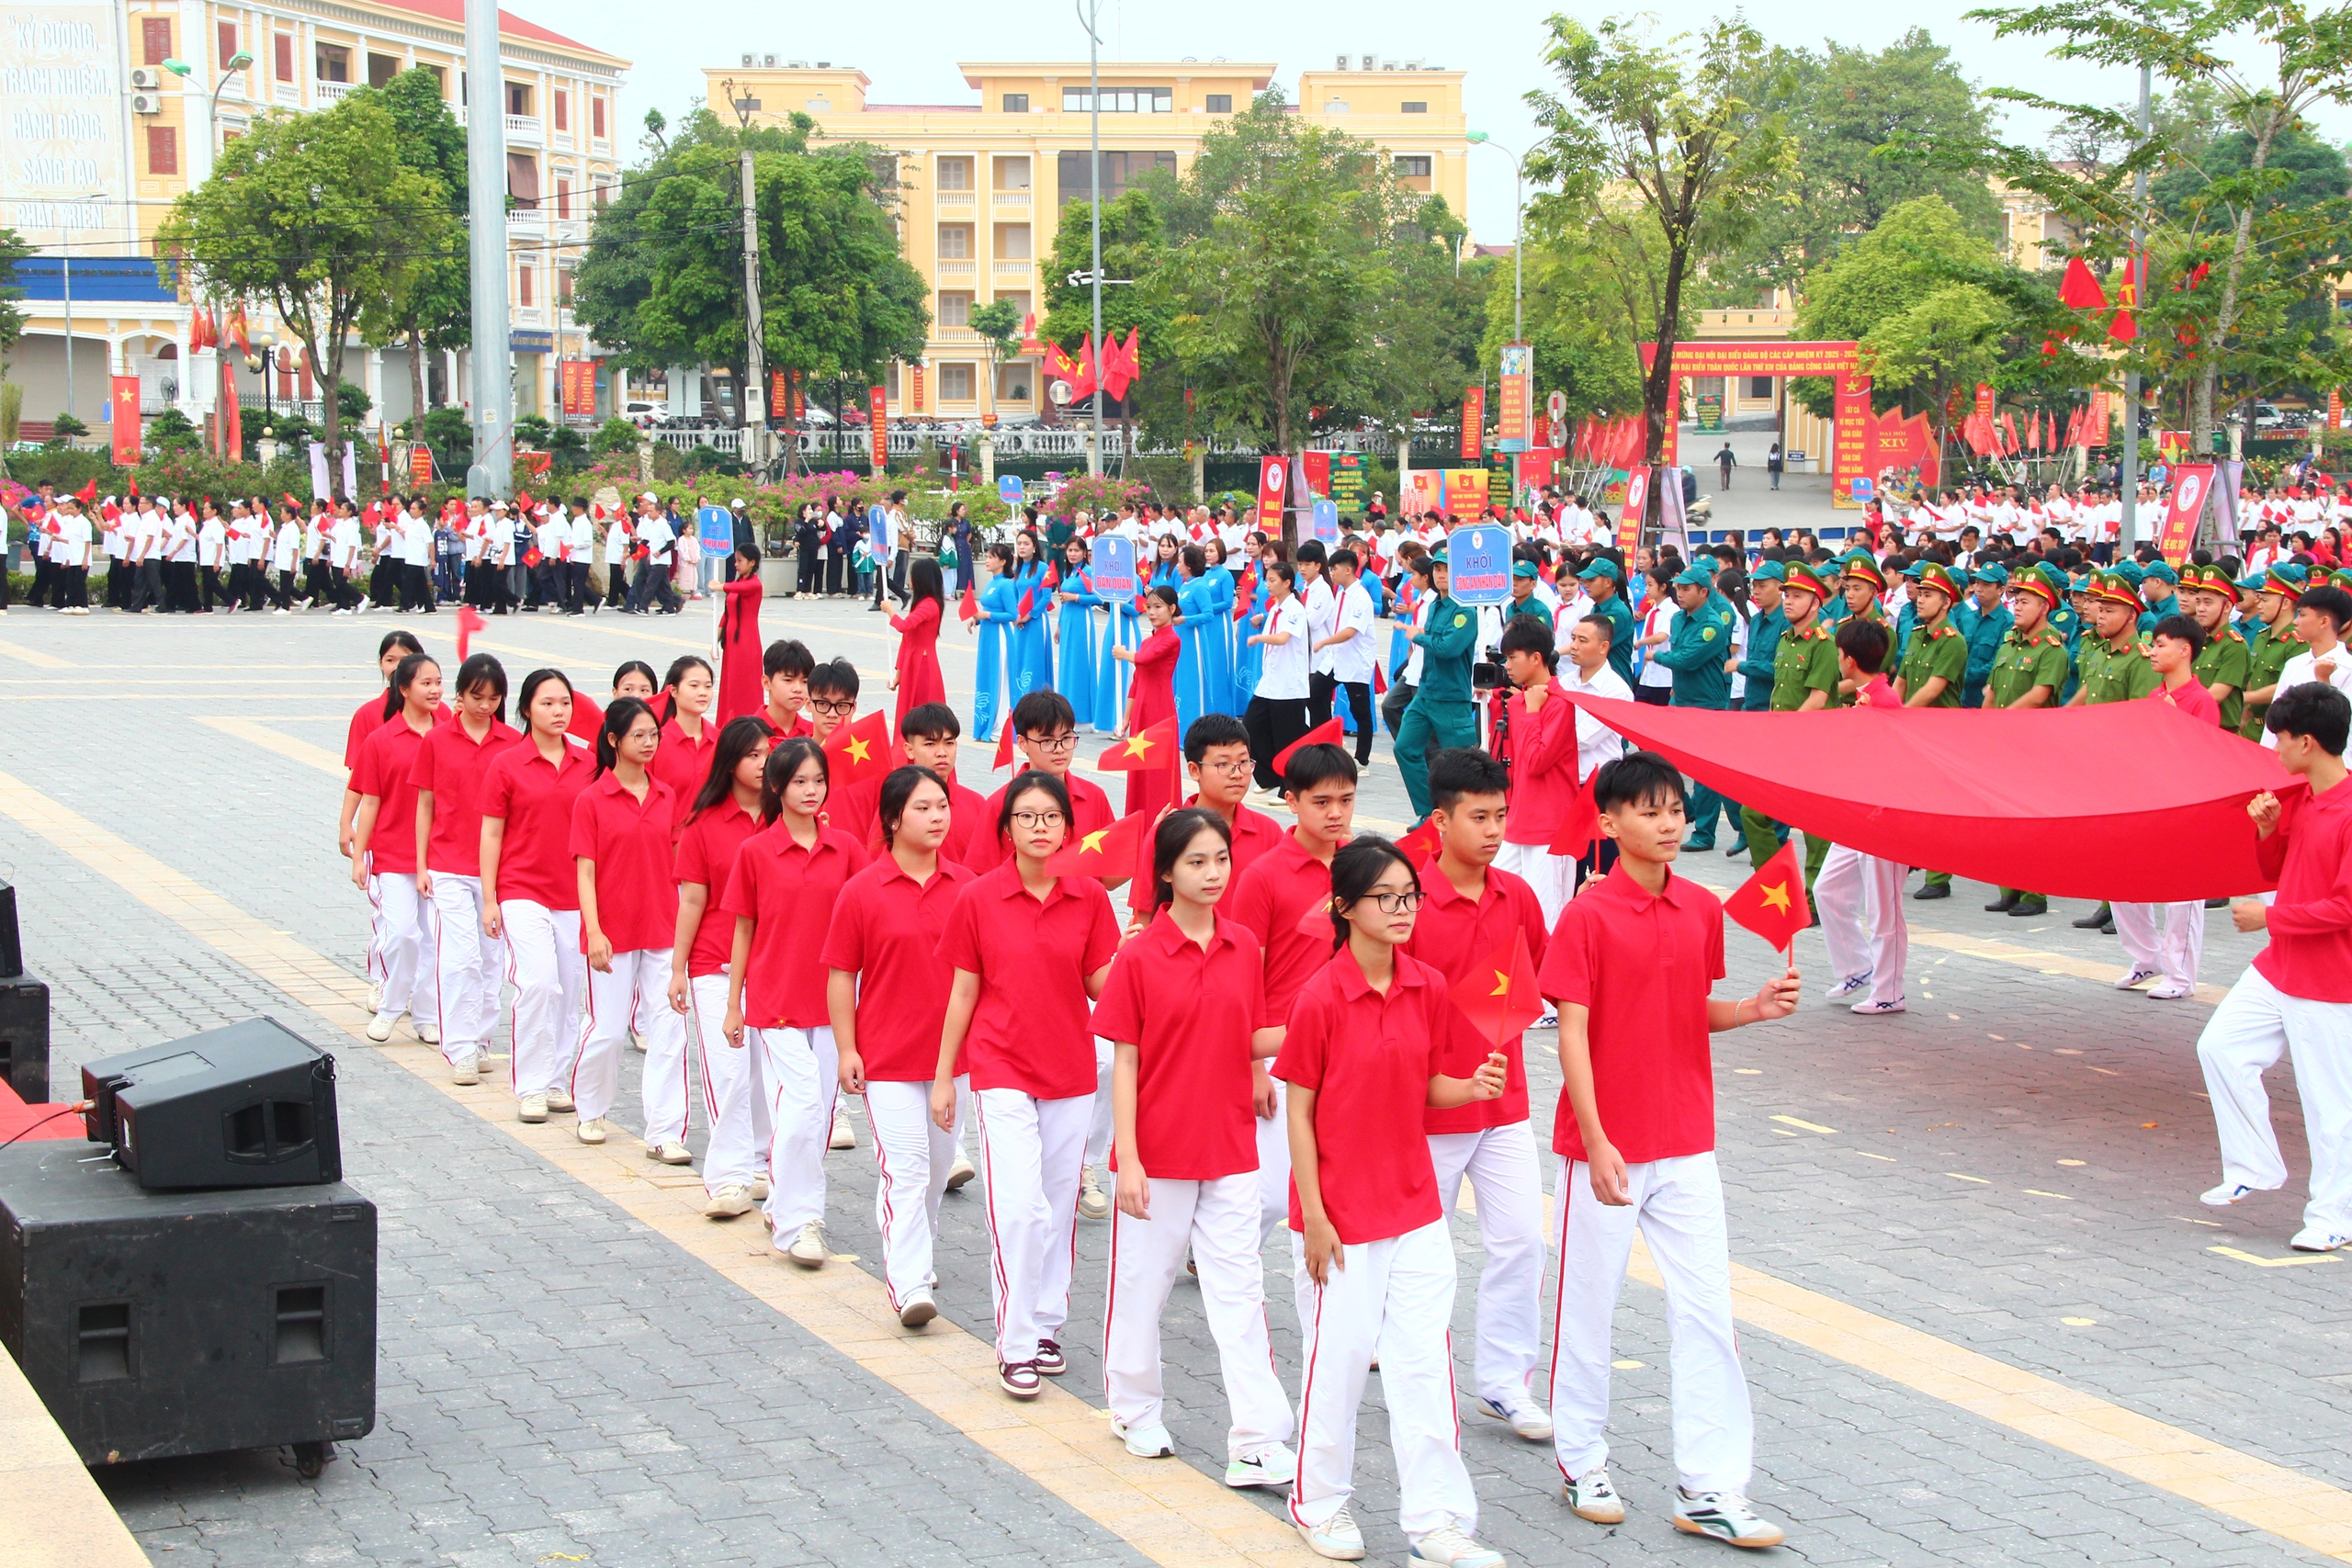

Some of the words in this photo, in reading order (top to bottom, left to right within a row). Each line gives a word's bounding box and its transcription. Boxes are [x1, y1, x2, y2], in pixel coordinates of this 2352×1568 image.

[41, 20, 99, 52] CƯƠNG,
[1, 62, 51, 94] TRÁCH
[56, 63, 111, 100] NHIỆM,
[12, 107, 55, 140] HÀNH
[59, 108, 107, 145] ĐỘNG,
[23, 153, 65, 185] SÁNG
[69, 158, 102, 190] TẠO,
[1676, 350, 1694, 360] MỪNG
[1694, 351, 1705, 362] ĐẠI
[1705, 350, 1716, 361] HỘI
[1716, 351, 1727, 362] ĐẠI
[1728, 349, 1742, 359] BIỂU
[1743, 349, 1759, 359] ĐẢNG
[1759, 350, 1769, 361] BỘ
[1769, 349, 1781, 359] CÁC
[1782, 348, 1794, 359] CẤP
[1795, 349, 1815, 360] NHIỆM
[1825, 350, 1839, 358] 2025
[1680, 363, 1691, 373] ĐẠI
[1691, 359, 1706, 371] BIỂU
[1706, 361, 1723, 371] TOÀN
[1724, 361, 1739, 372] QUỐC
[1739, 360, 1752, 371] LẦN
[1753, 361, 1764, 371] THỨ
[1764, 362, 1774, 371] XIV
[1775, 360, 1788, 371] CỦA
[1788, 361, 1805, 371] ĐẢNG
[1805, 361, 1822, 372] CỘNG
[1823, 360, 1836, 370] SẢN
[1836, 360, 1849, 371] VIỆT
[1841, 429, 1851, 438] DÂN
[1879, 438, 1908, 447] XIV
[1841, 453, 1851, 462] DÂN
[1838, 465, 1851, 474] CÔNG
[1839, 476, 1849, 486] VĂN
[2172, 518, 2186, 533] KHỎE
[2169, 539, 2178, 552] HỌC
[1465, 549, 1493, 570] KHỐI
[1096, 574, 1111, 589] DÂN
[1112, 575, 1132, 591] QUÂN
[1493, 571, 1507, 589] DÂN
